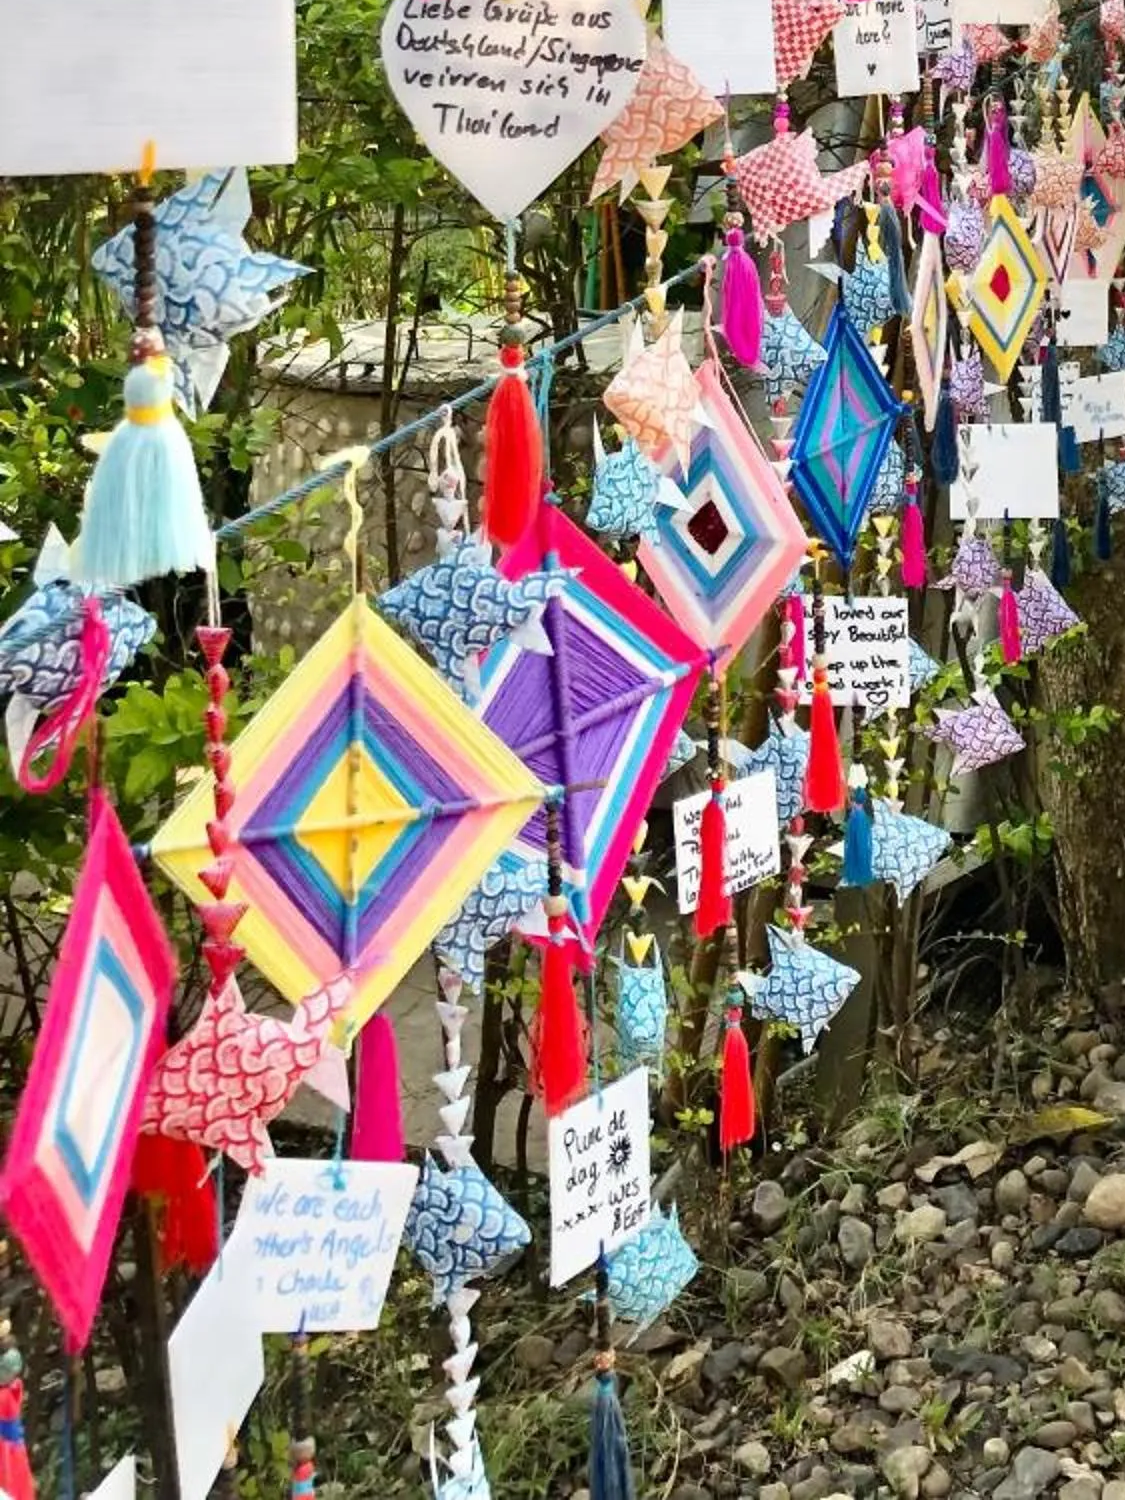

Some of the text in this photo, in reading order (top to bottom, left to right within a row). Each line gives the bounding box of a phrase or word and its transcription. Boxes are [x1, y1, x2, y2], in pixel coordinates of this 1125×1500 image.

[571, 11, 612, 29] aus
[433, 102, 560, 139] Thailand
[833, 604, 876, 621] loved
[849, 659, 869, 673] up
[871, 654, 901, 669] the
[565, 1161, 601, 1197] dag
[254, 1181, 289, 1217] We
[333, 1187, 383, 1222] each
